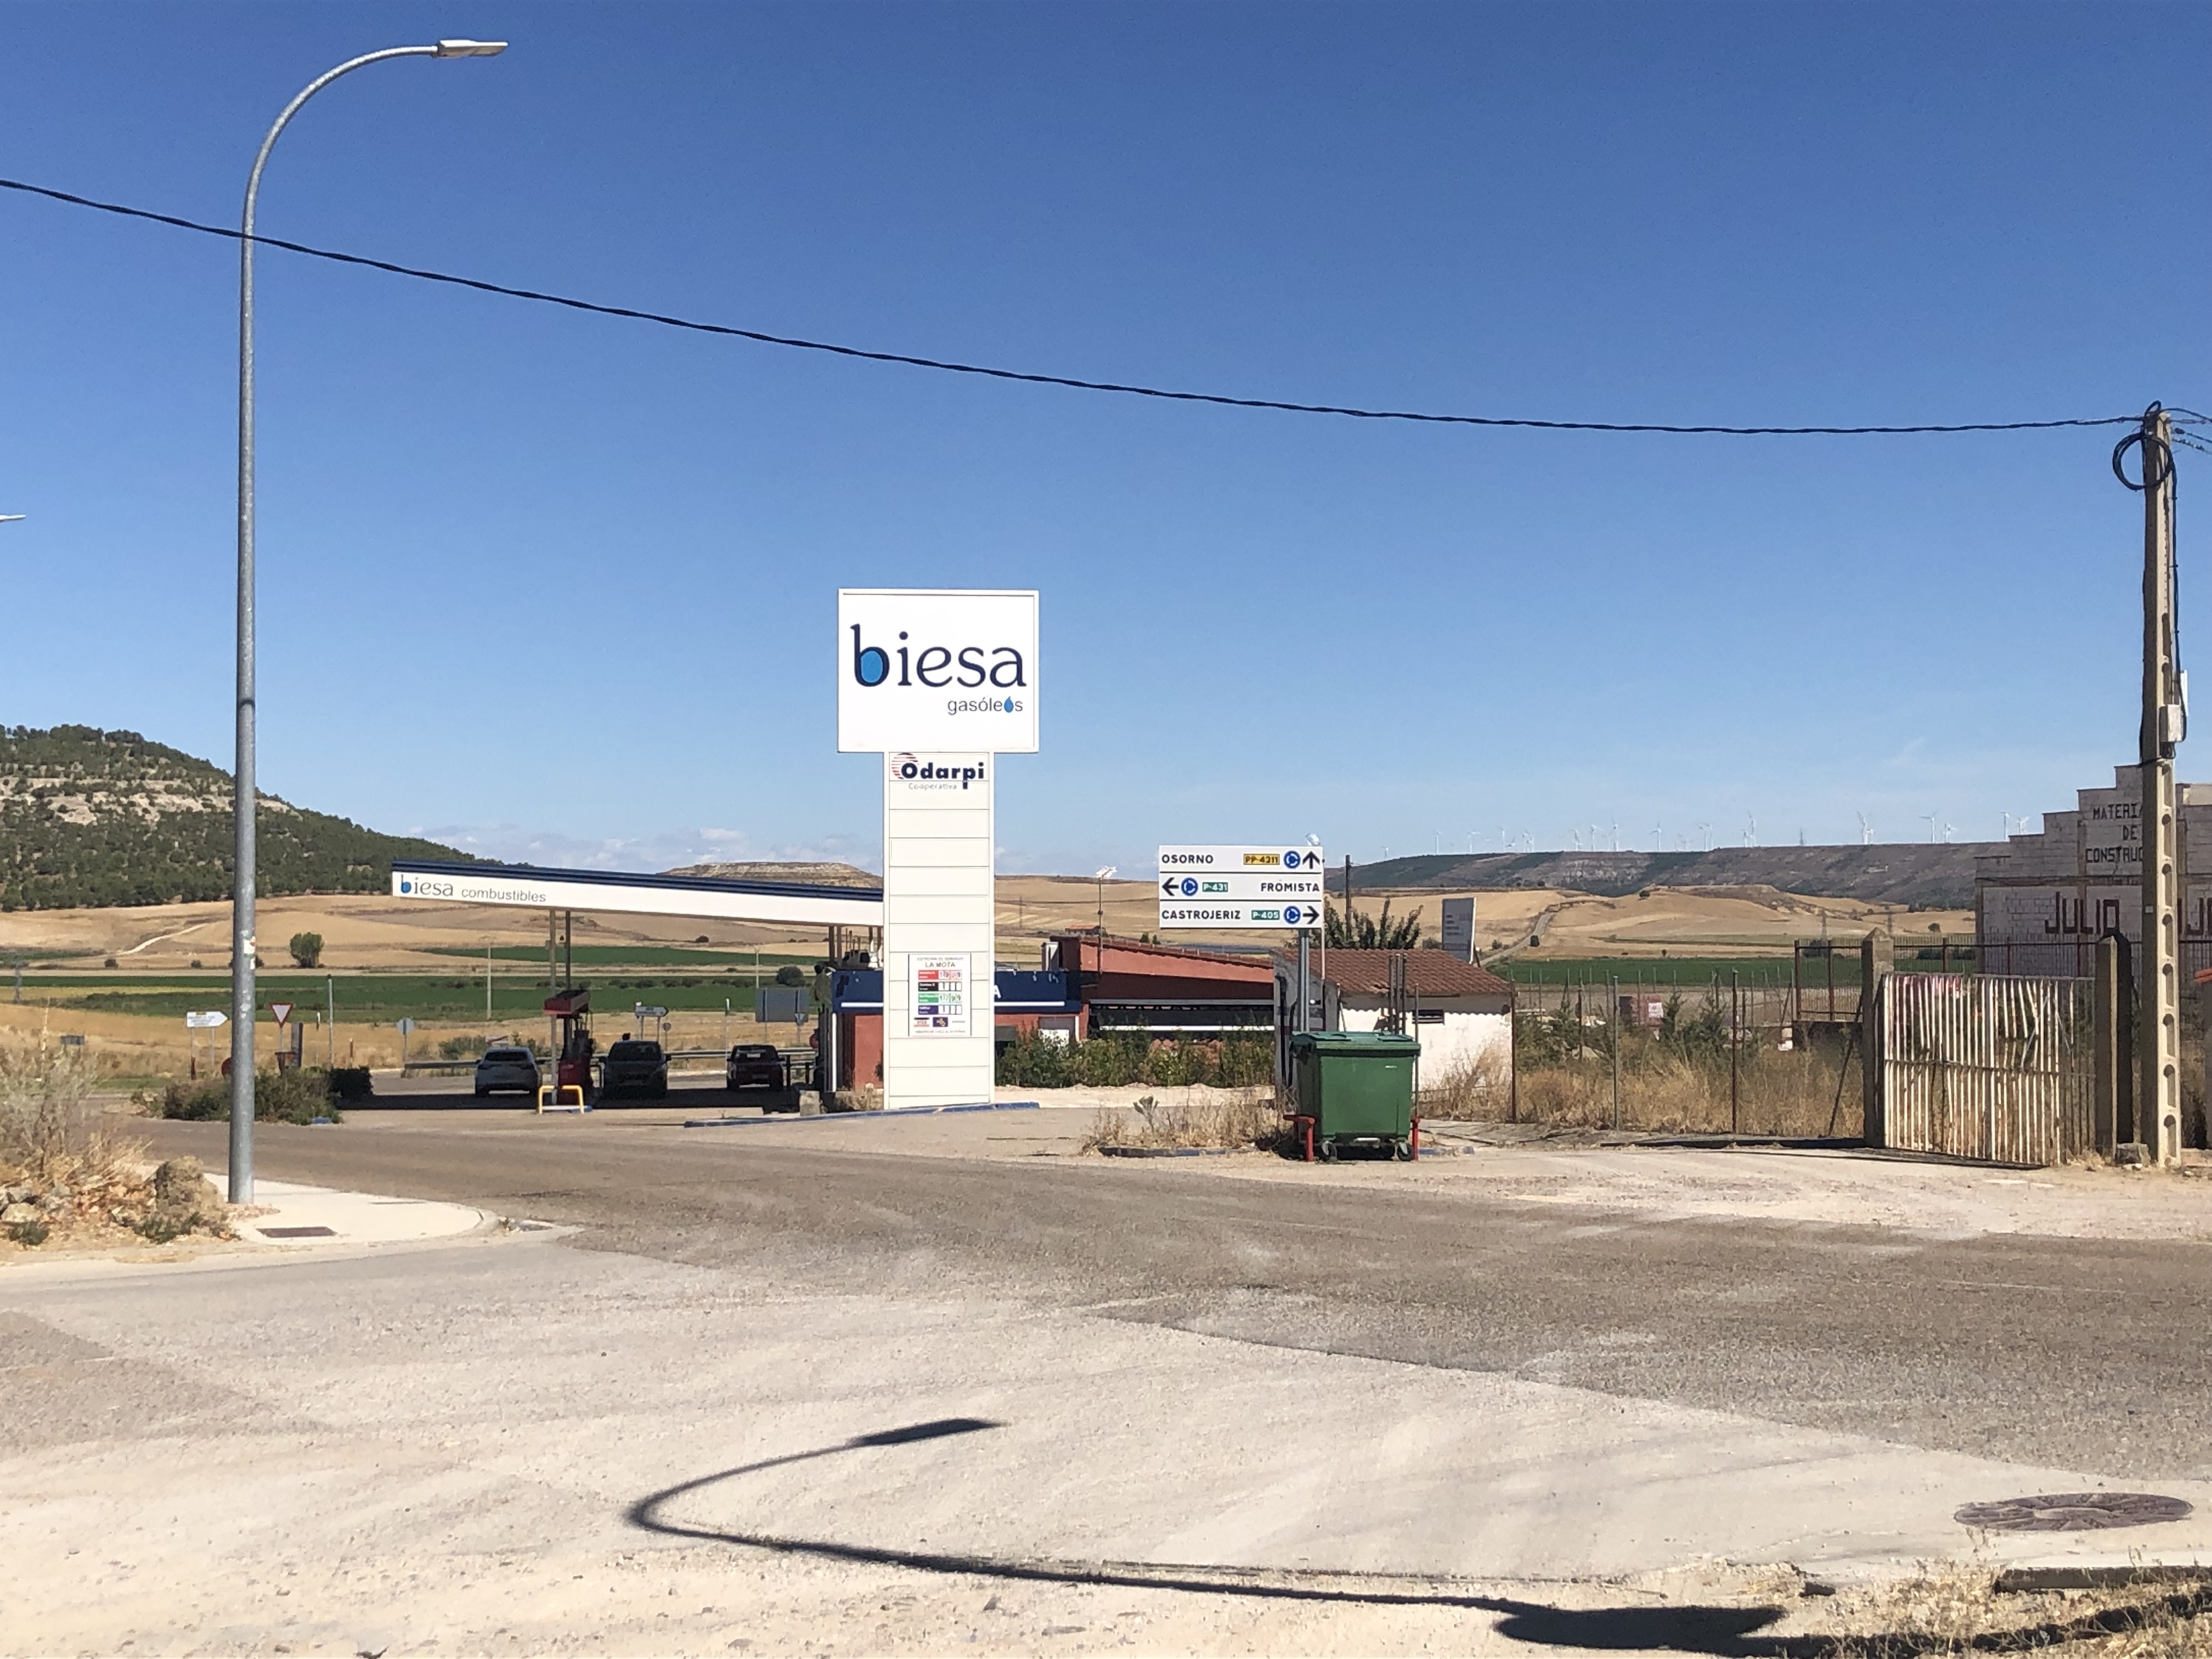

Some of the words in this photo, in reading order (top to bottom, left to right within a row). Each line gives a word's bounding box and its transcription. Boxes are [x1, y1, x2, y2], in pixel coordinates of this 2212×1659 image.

[850, 624, 1026, 687] biesa
[901, 761, 984, 789] Odarpi
[2123, 825, 2137, 840] DE
[1161, 854, 1214, 864] OSORNO
[400, 874, 454, 897] biesa
[461, 888, 546, 902] combustibles
[1203, 883, 1227, 891] P-431
[1161, 910, 1241, 919] CASTROJERIZ
[2045, 891, 2119, 934] JULIO
